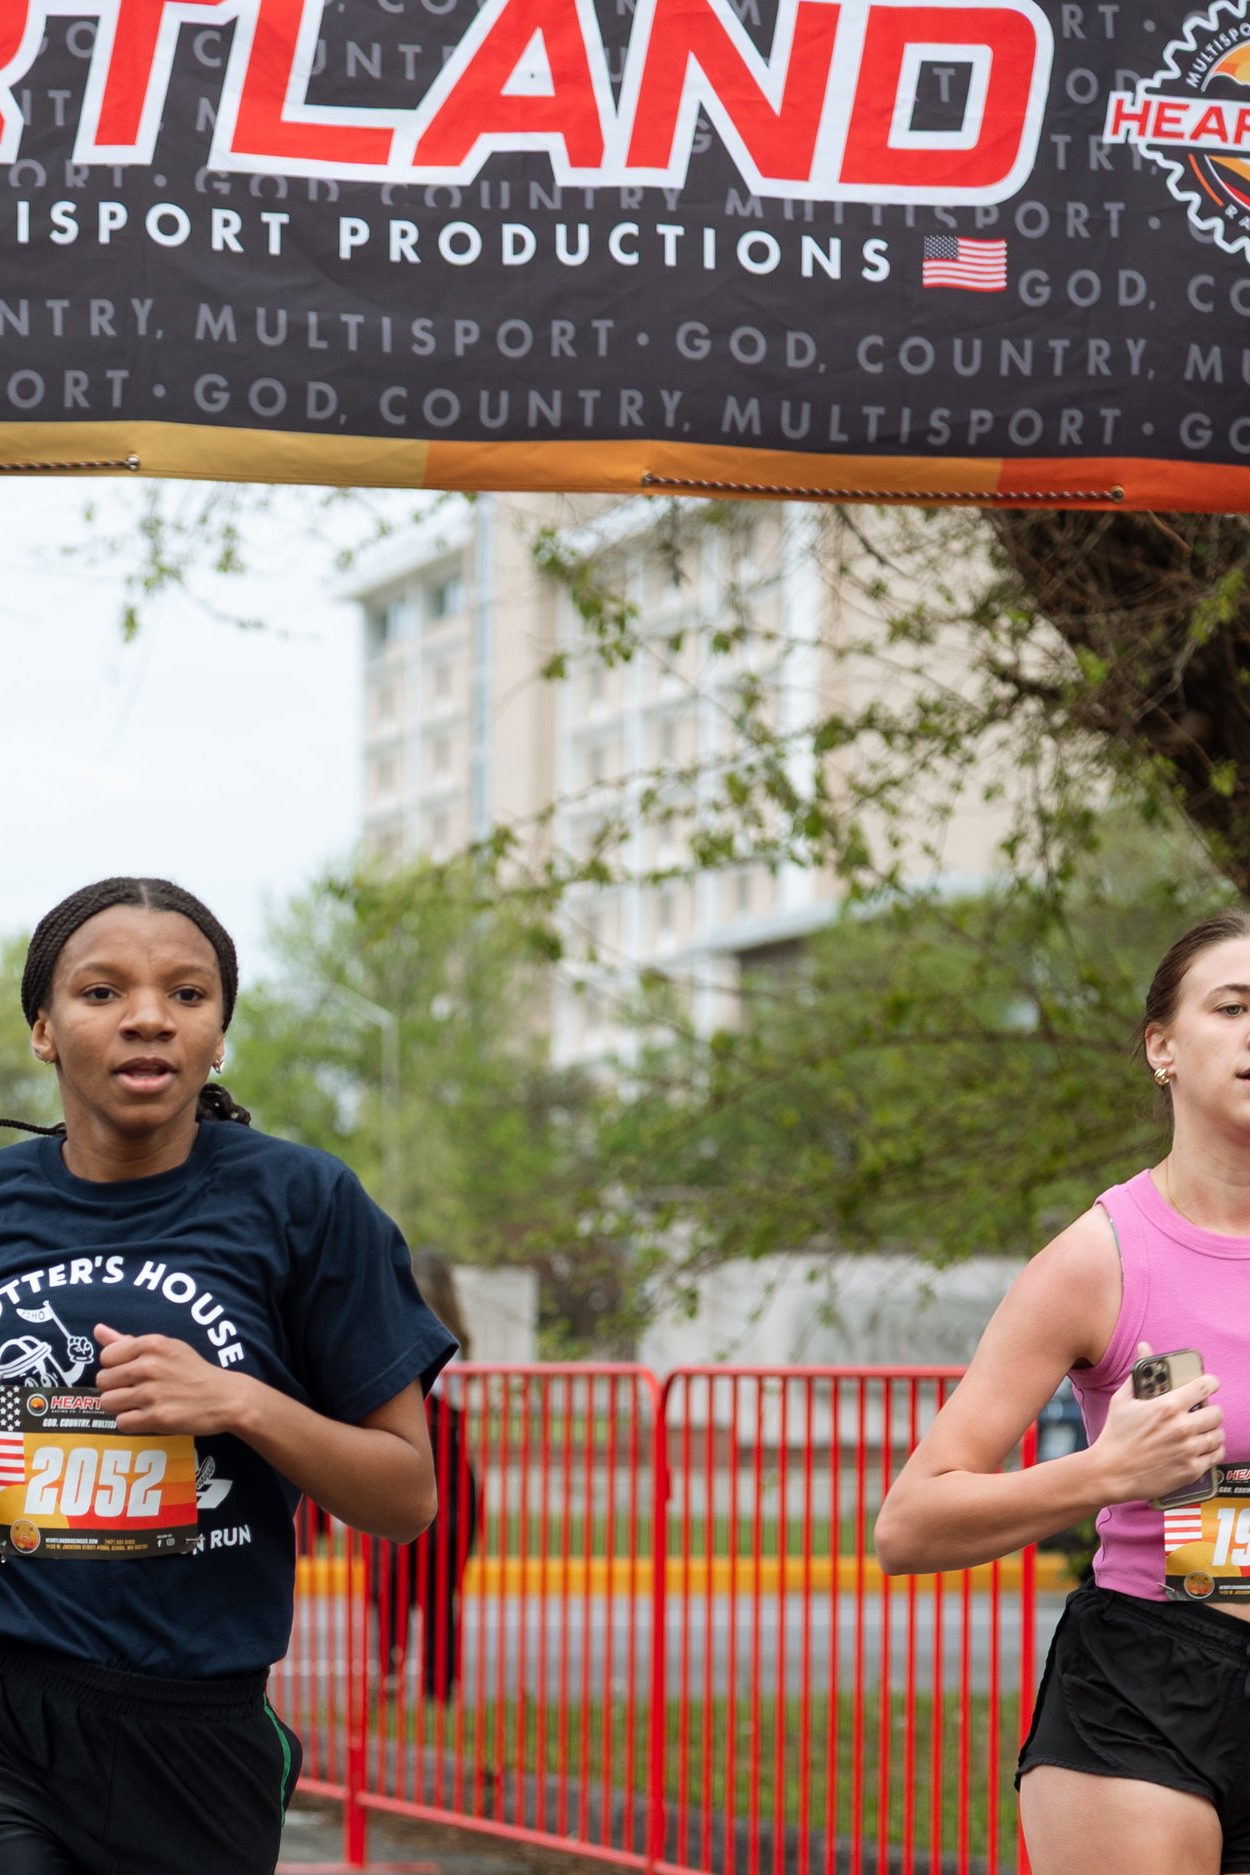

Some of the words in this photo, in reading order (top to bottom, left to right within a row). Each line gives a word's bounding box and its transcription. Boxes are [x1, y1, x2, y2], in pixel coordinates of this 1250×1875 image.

[339, 217, 890, 282] PRODUCTIONS
[1018, 268, 1157, 311] GOD,
[195, 304, 615, 358] MULTISPORT
[676, 321, 827, 374] GOD,
[857, 335, 1156, 379] COUNTRY,
[194, 373, 347, 425] GOD,
[380, 385, 690, 432] COUNTRY,
[722, 396, 1120, 446] MULTISPORT
[133, 1261, 244, 1368] HOUSE
[24, 1447, 167, 1517] 2052
[210, 1524, 251, 1549] RUN
